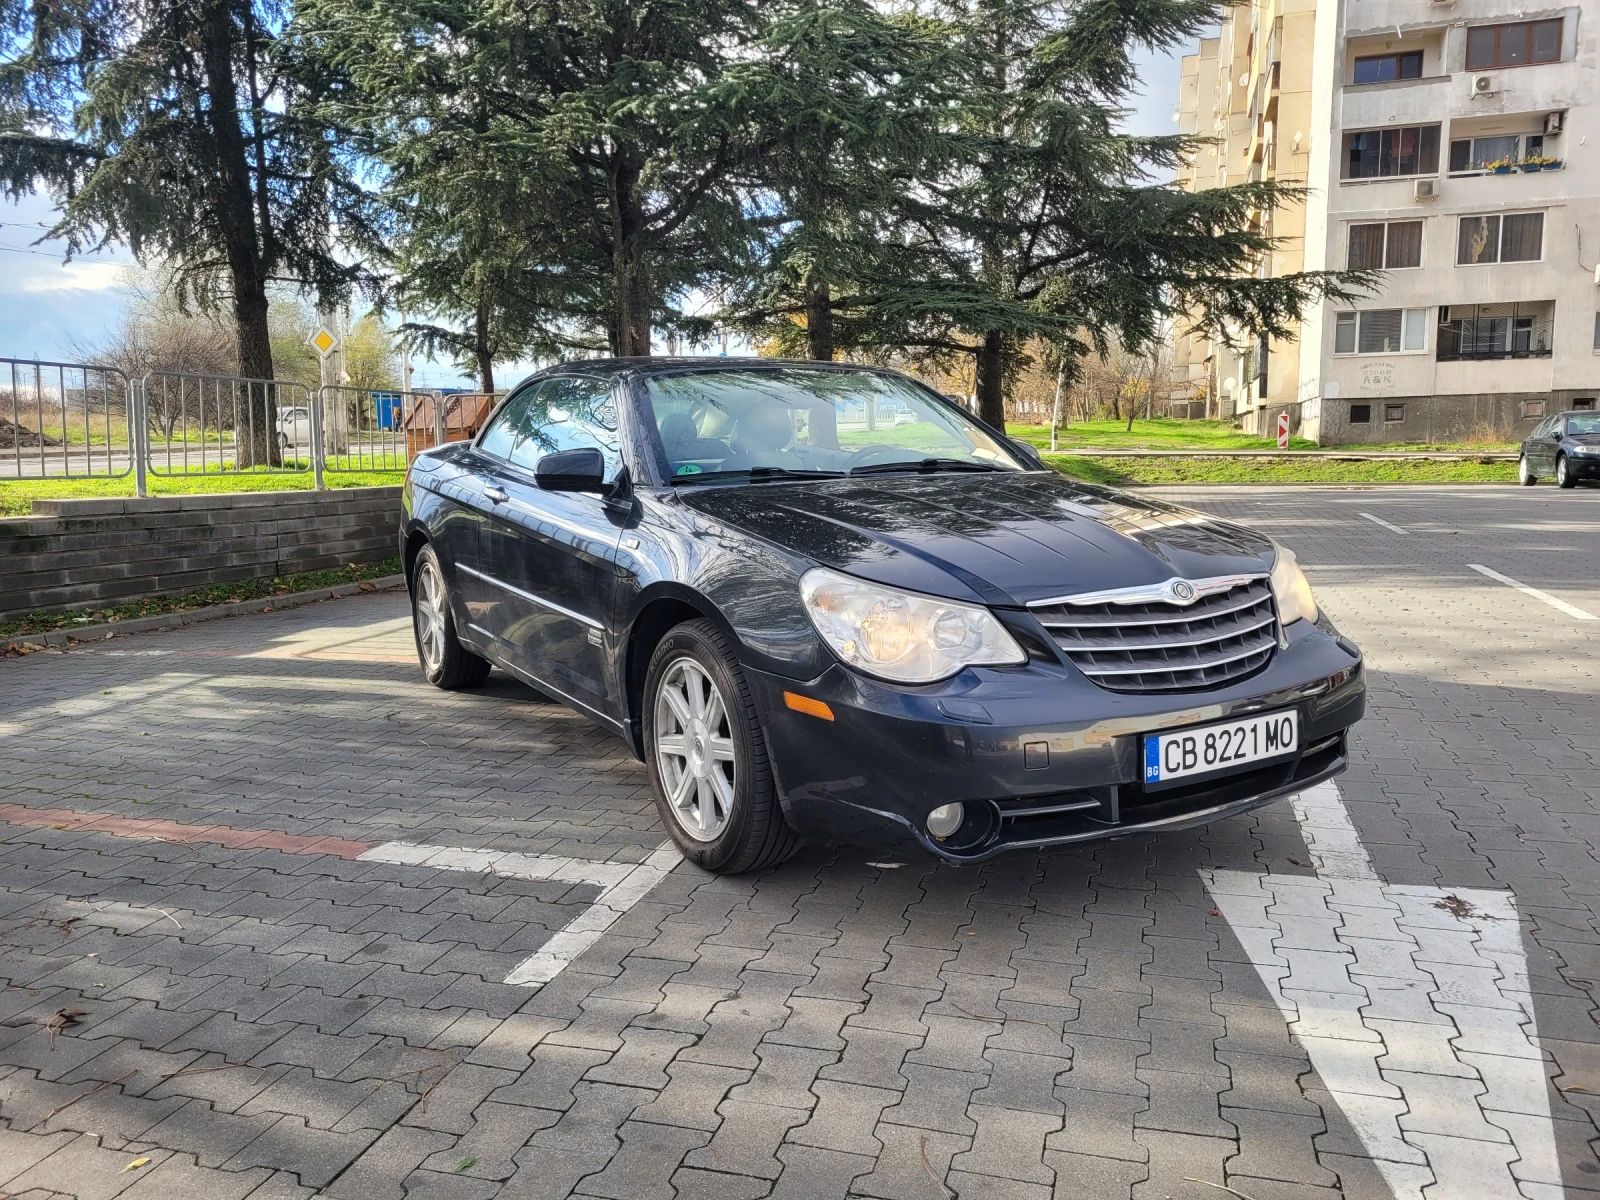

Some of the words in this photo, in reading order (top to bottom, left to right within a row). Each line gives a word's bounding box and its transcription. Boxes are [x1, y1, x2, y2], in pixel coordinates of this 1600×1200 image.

[650, 638, 674, 673] KUMHO
[1165, 736, 1198, 773] CB
[1203, 723, 1258, 765] 8221
[1265, 716, 1293, 752] MO
[1147, 765, 1159, 777] BG
